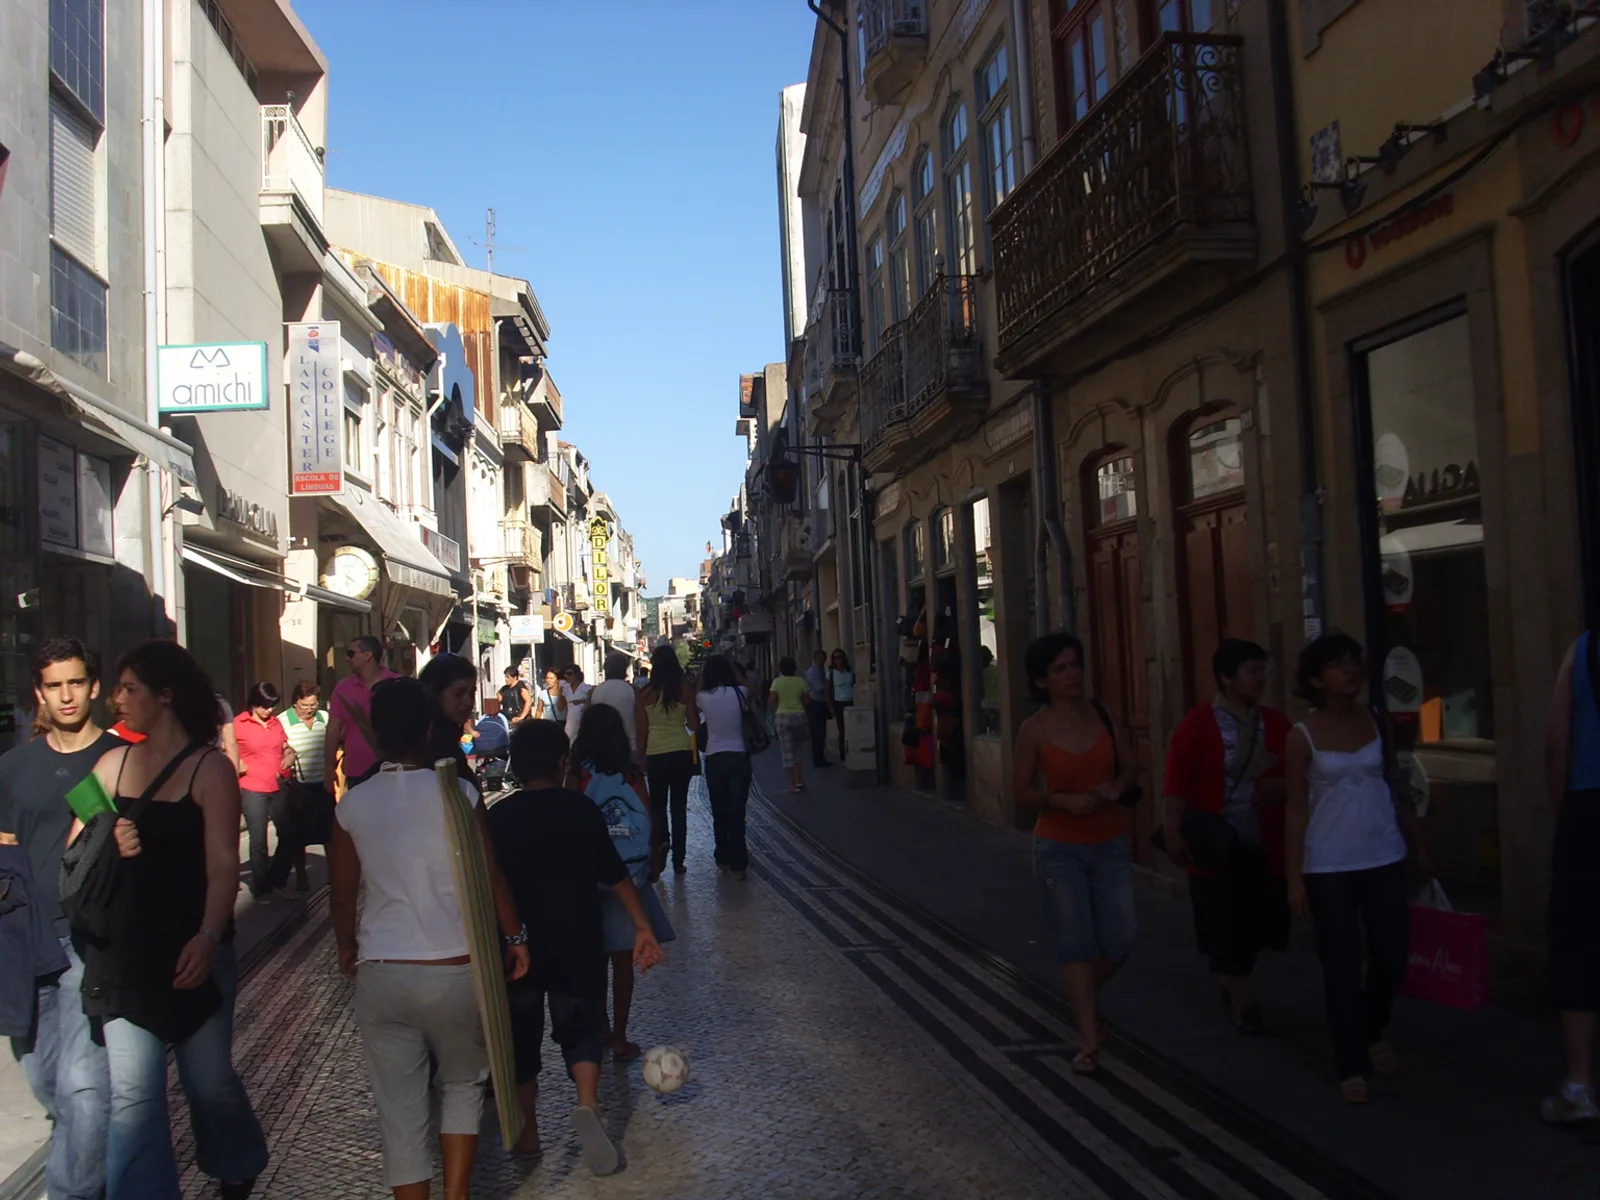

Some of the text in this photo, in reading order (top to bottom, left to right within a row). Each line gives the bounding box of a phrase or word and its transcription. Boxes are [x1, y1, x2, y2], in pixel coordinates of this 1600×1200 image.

[173, 371, 252, 405] amichi
[300, 355, 313, 471] LANCASTER
[322, 367, 335, 458] COLLEGE
[595, 537, 606, 609] DILOR
